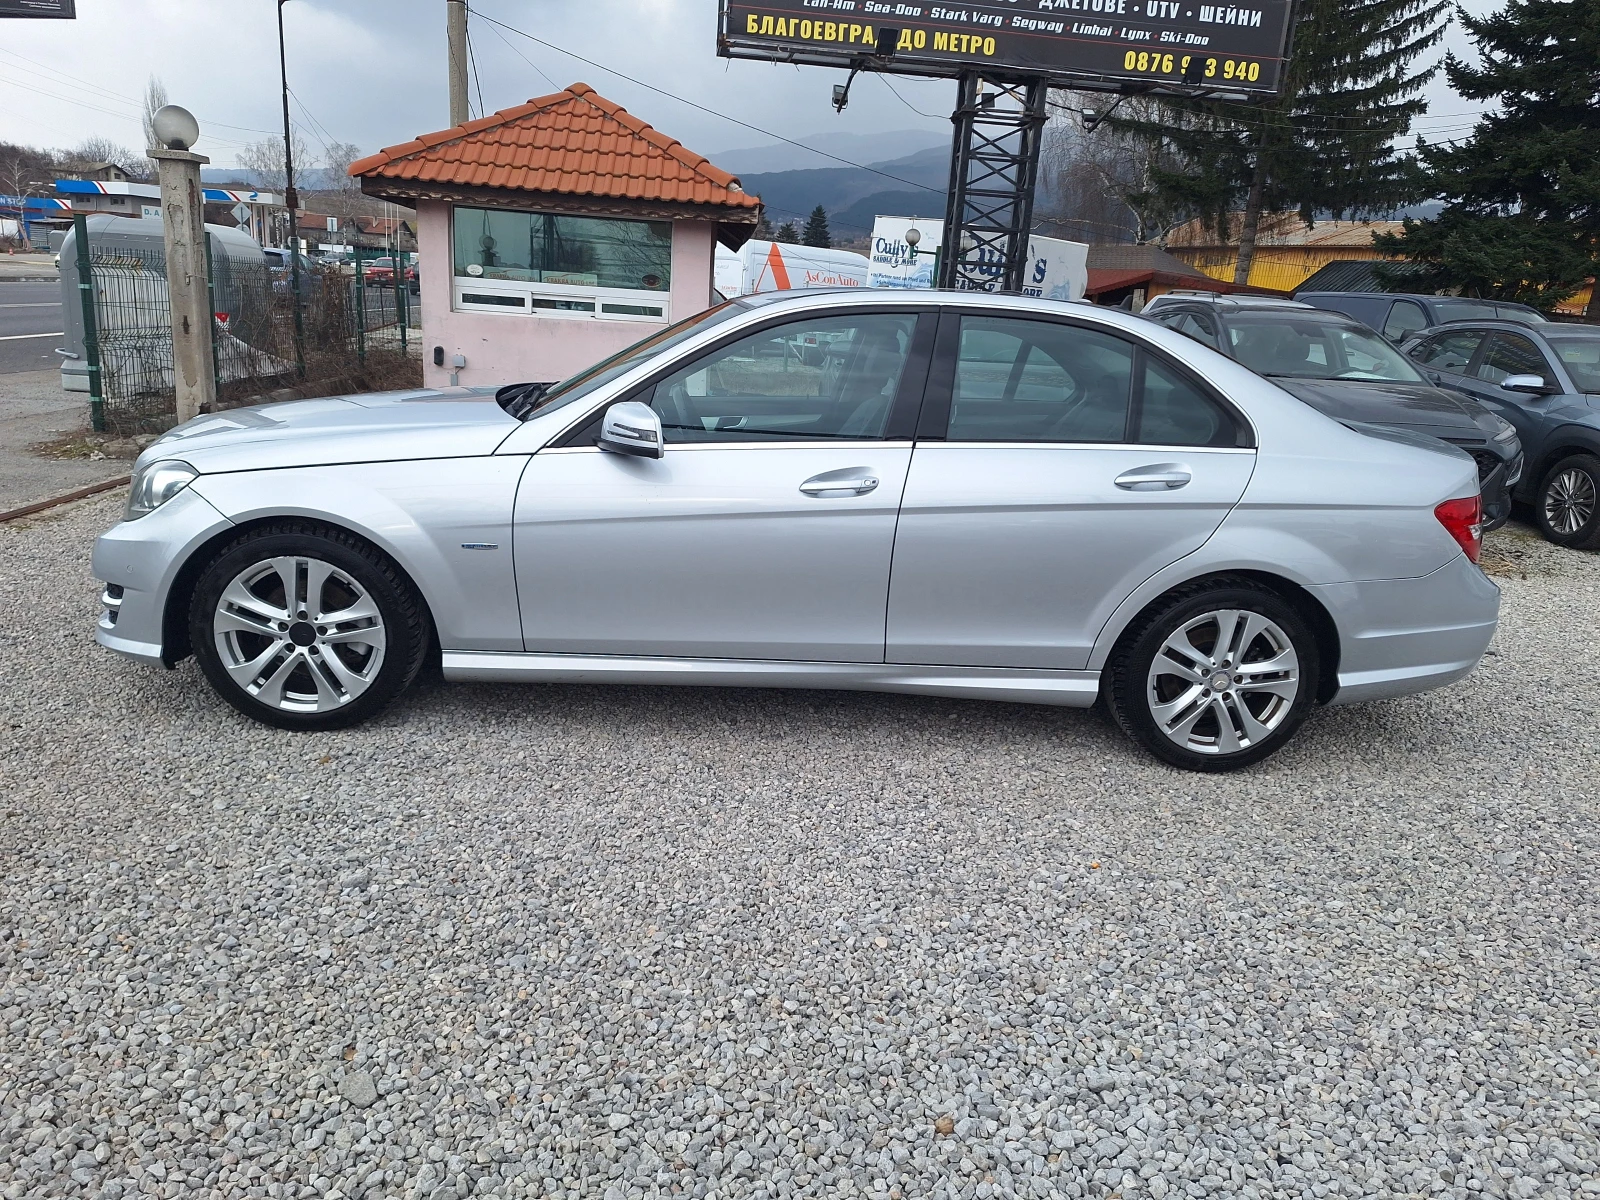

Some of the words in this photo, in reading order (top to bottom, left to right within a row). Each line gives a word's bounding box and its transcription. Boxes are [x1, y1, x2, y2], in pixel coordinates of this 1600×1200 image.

[864, 1, 921, 16] Sea-Doo
[930, 7, 969, 22] Stark
[972, 12, 1003, 27] Varg
[1012, 16, 1064, 33] Segway
[1072, 22, 1113, 37] Linhai
[1120, 27, 1152, 41] Lynx
[1160, 31, 1210, 46] Ski-Doo
[1146, 1, 1180, 19] UTV
[1199, 4, 1263, 27] ШЕЙНИ
[746, 14, 879, 48] БЛАГОЕВГРА
[896, 28, 926, 51] ДО
[933, 32, 995, 56] МЕТРО
[1124, 50, 1174, 74] 0876
[1180, 55, 1217, 77] 93
[1223, 60, 1260, 82] 940
[804, 269, 859, 288] AsConAuto
